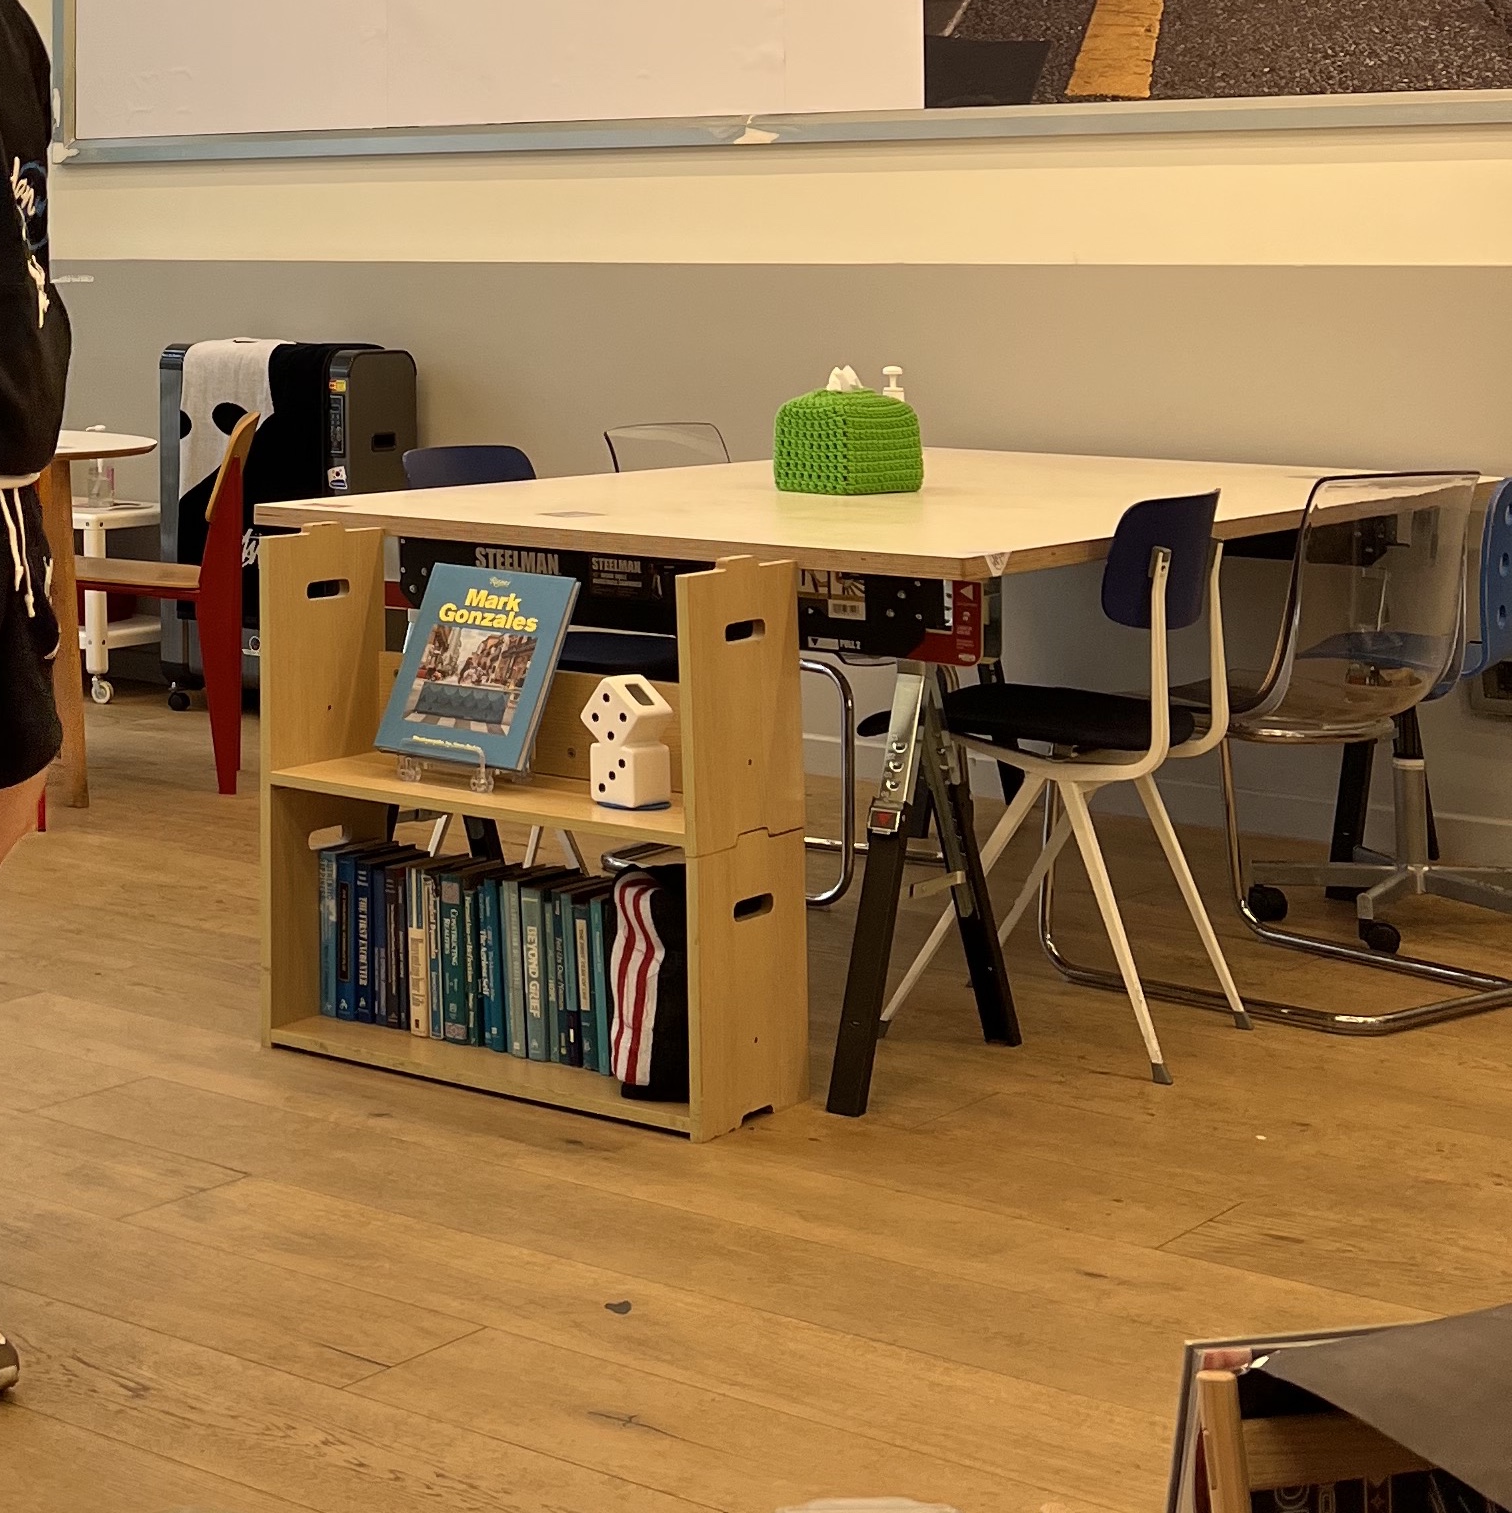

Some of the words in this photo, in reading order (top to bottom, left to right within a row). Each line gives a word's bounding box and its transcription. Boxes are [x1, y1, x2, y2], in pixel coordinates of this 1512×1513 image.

[474, 547, 561, 575] STEELMAN
[591, 557, 642, 575] STEELMAN
[464, 588, 523, 613] Mark
[439, 603, 540, 633] Gonzales
[358, 897, 368, 911] THE
[358, 914, 368, 939] FIRST
[526, 925, 539, 978] BEYOND
[529, 980, 541, 1018] GRIEF
